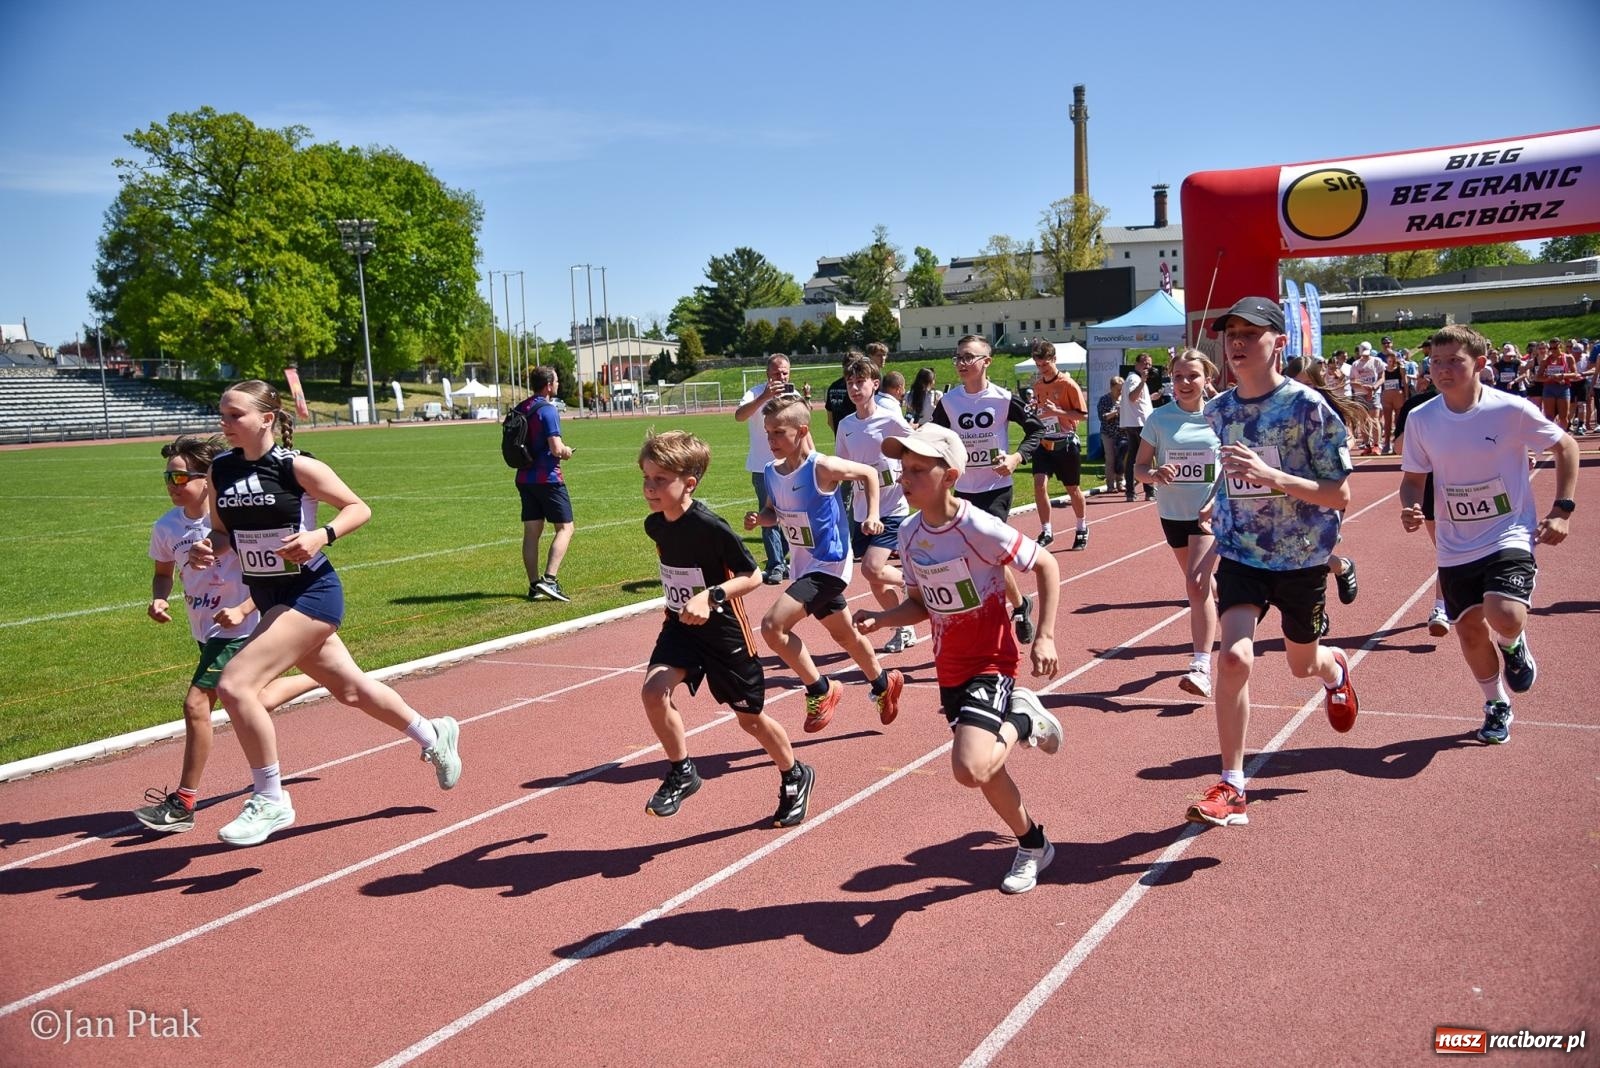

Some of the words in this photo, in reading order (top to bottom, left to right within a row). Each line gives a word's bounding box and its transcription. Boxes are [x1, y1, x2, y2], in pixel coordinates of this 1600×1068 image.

[1445, 147, 1524, 171] BIEG
[1323, 175, 1366, 192] SIR
[1390, 181, 1453, 206] BEZ
[1458, 166, 1582, 199] GRANIC
[1405, 200, 1565, 233] RACIBÓRZ
[958, 411, 994, 430] GO
[218, 492, 276, 509] adidas
[1456, 500, 1490, 516] 014
[246, 550, 277, 567] 016
[923, 584, 953, 605] 010
